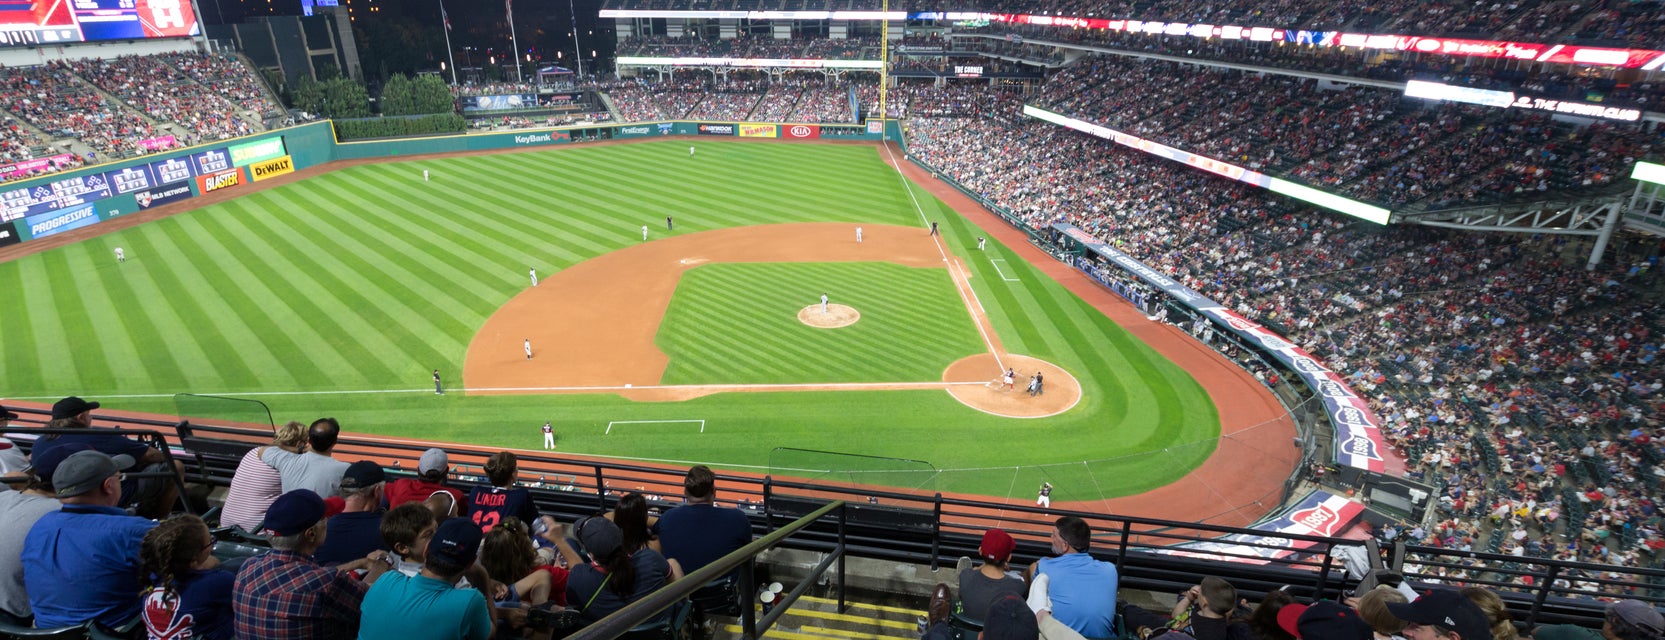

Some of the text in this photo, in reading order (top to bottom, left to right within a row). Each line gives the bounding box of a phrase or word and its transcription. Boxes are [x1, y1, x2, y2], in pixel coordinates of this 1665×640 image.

[964, 66, 983, 74] CORNER
[1534, 98, 1558, 110] THE
[1603, 107, 1640, 121] CLUB
[515, 134, 551, 144] KeyBank
[621, 127, 650, 135] FirstEnergy
[793, 127, 809, 135] KIA
[233, 140, 282, 162] SUBWAY
[205, 171, 239, 192] BLASTER
[152, 186, 189, 200] MLB NETWORK
[32, 206, 93, 235] PROGRESSIVE
[1344, 405, 1361, 426] 1999
[1352, 434, 1368, 456] 1998
[1301, 509, 1333, 528] 1997
